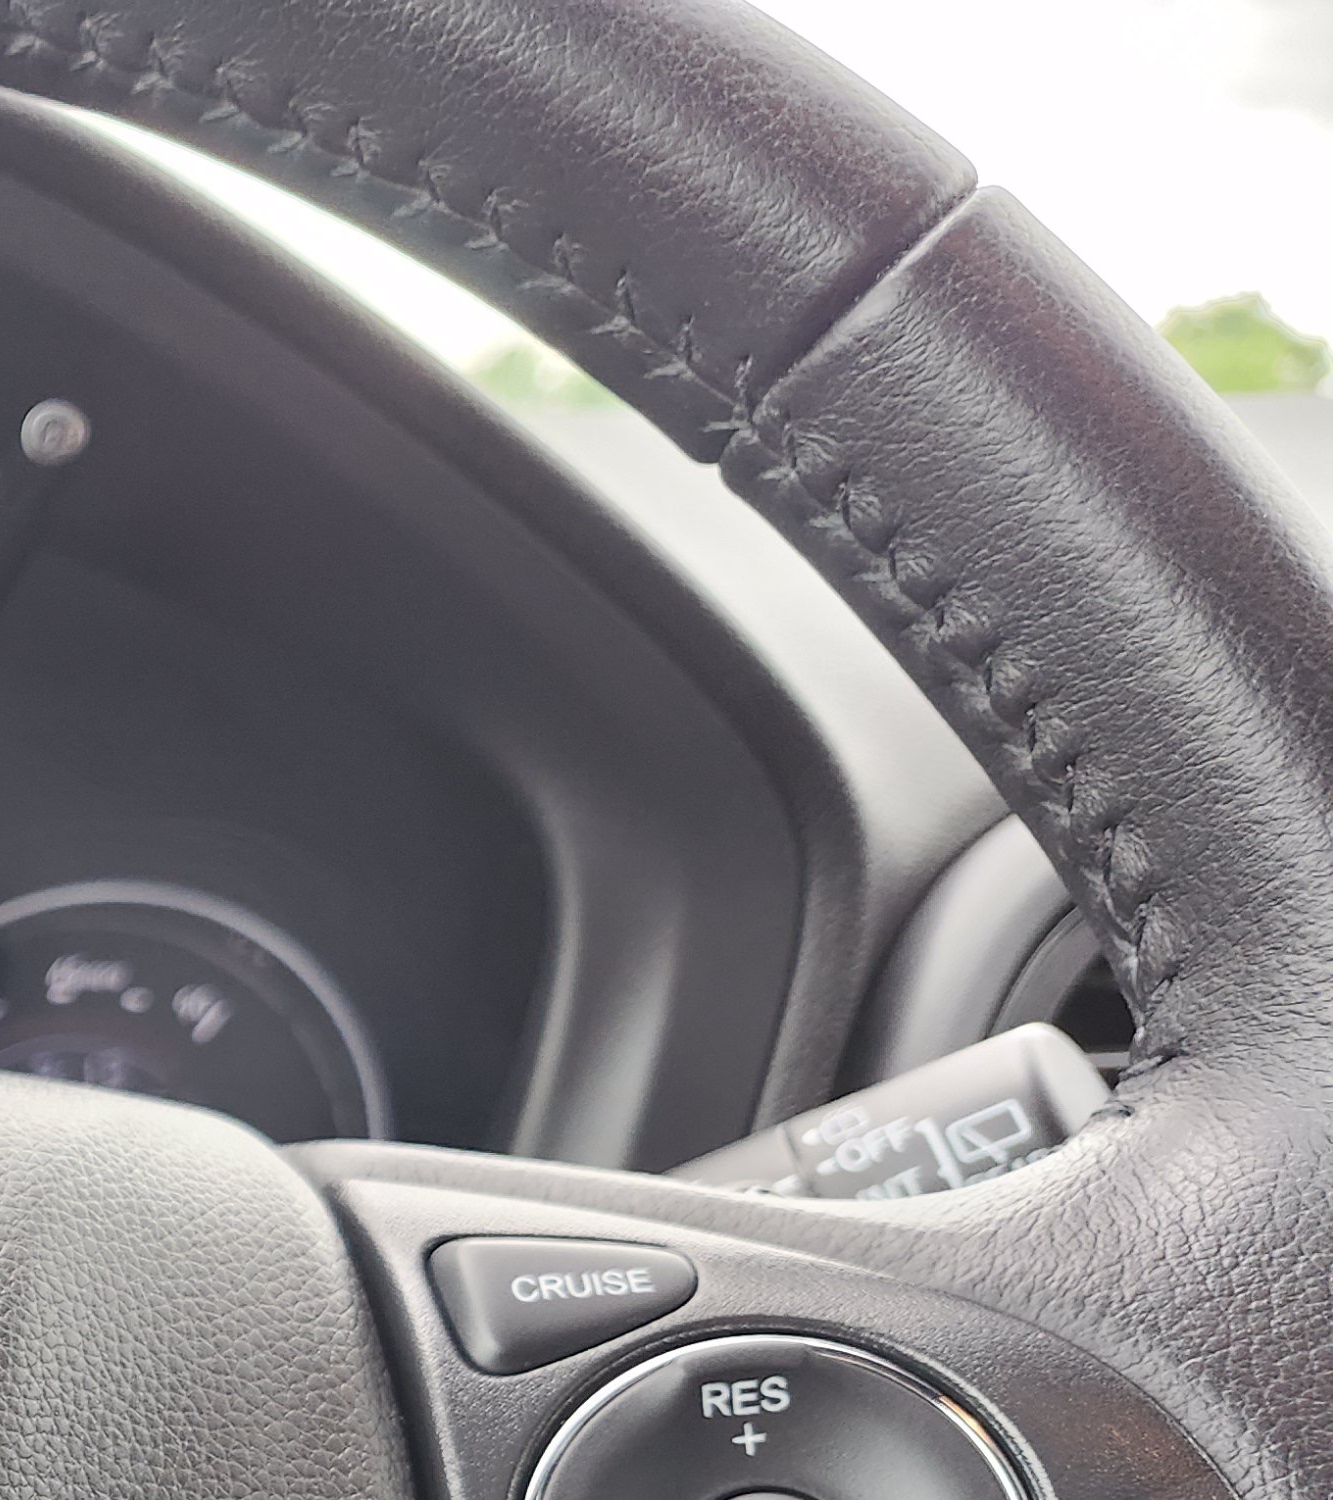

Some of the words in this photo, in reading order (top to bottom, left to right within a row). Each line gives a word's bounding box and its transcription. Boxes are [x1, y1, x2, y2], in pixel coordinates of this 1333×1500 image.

[835, 1116, 913, 1172] OFF
[511, 1267, 656, 1304] CRUISE
[700, 1375, 791, 1418] RES
